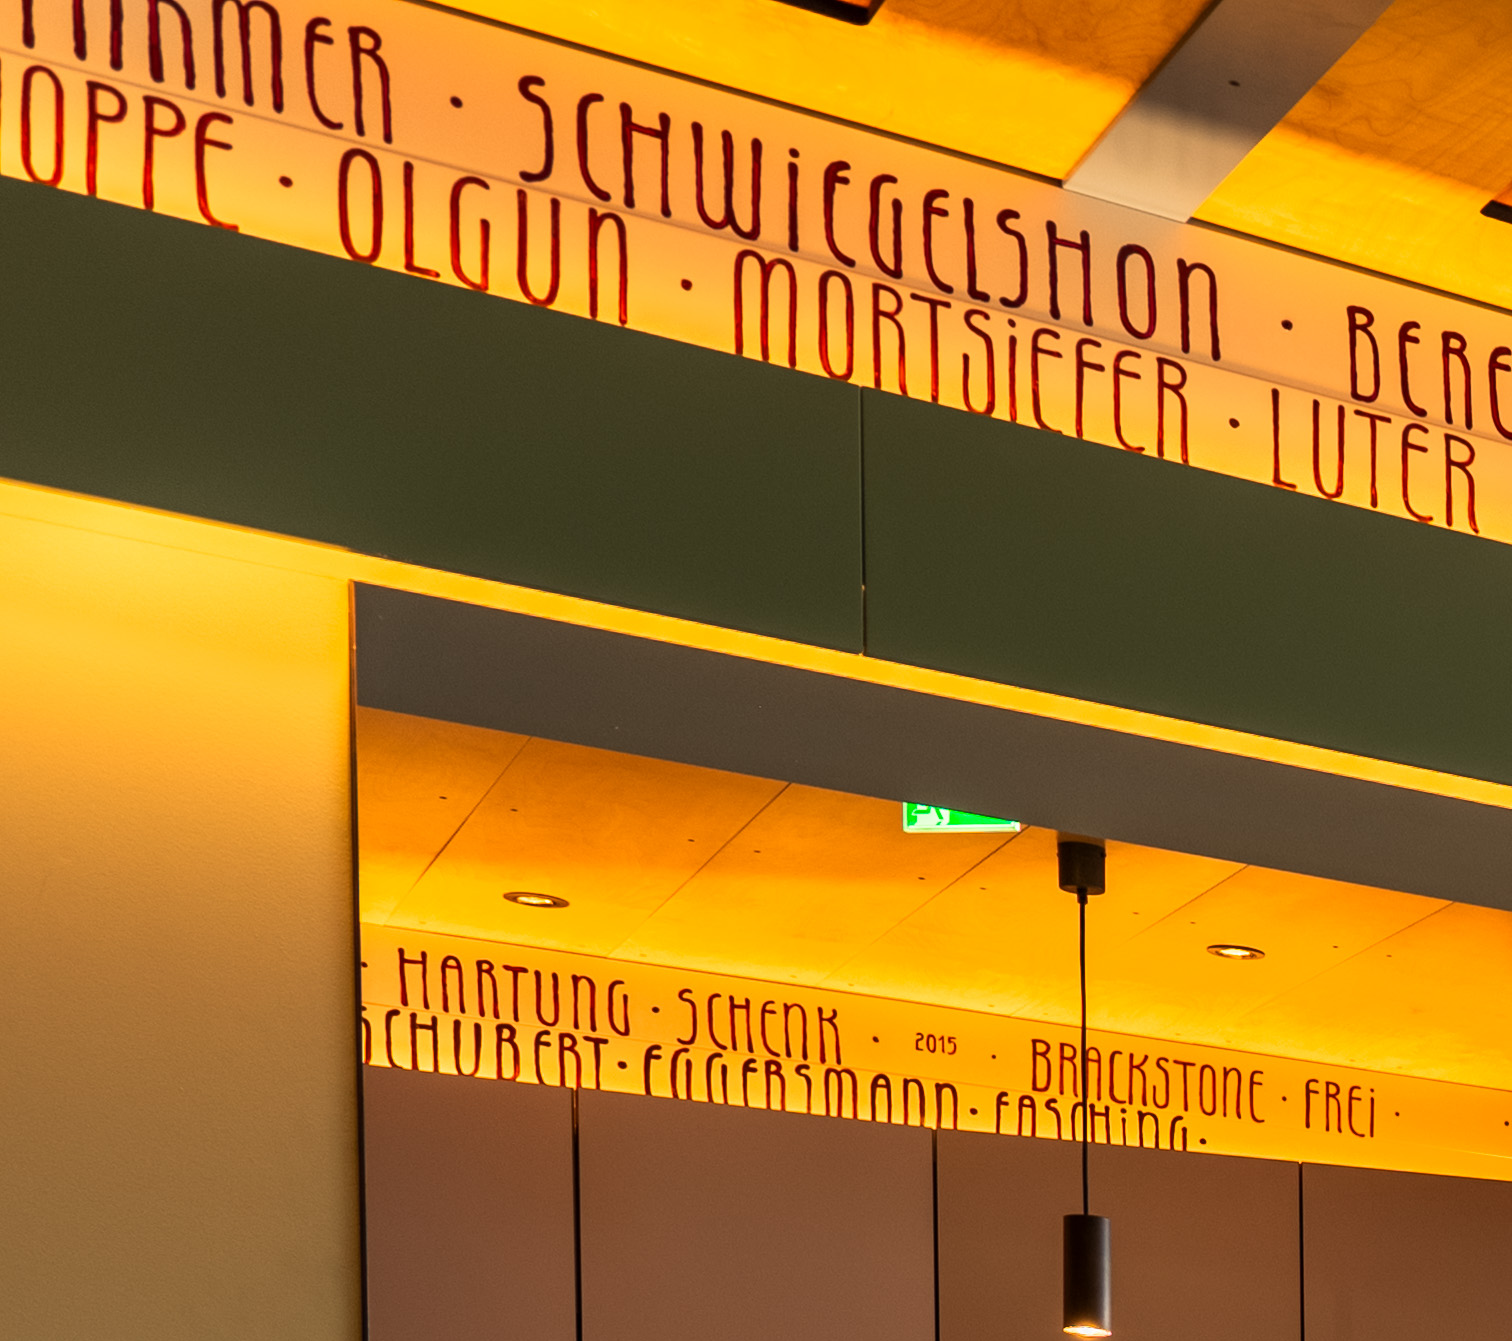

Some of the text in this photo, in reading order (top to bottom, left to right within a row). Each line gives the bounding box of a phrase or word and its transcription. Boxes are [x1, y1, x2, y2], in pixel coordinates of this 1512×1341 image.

[339, 149, 629, 326] OLGUN
[1271, 388, 1479, 535] LUTER
[397, 947, 1376, 1138] HARTUNG SCHENK 2015 BRACKSTONE FREI
